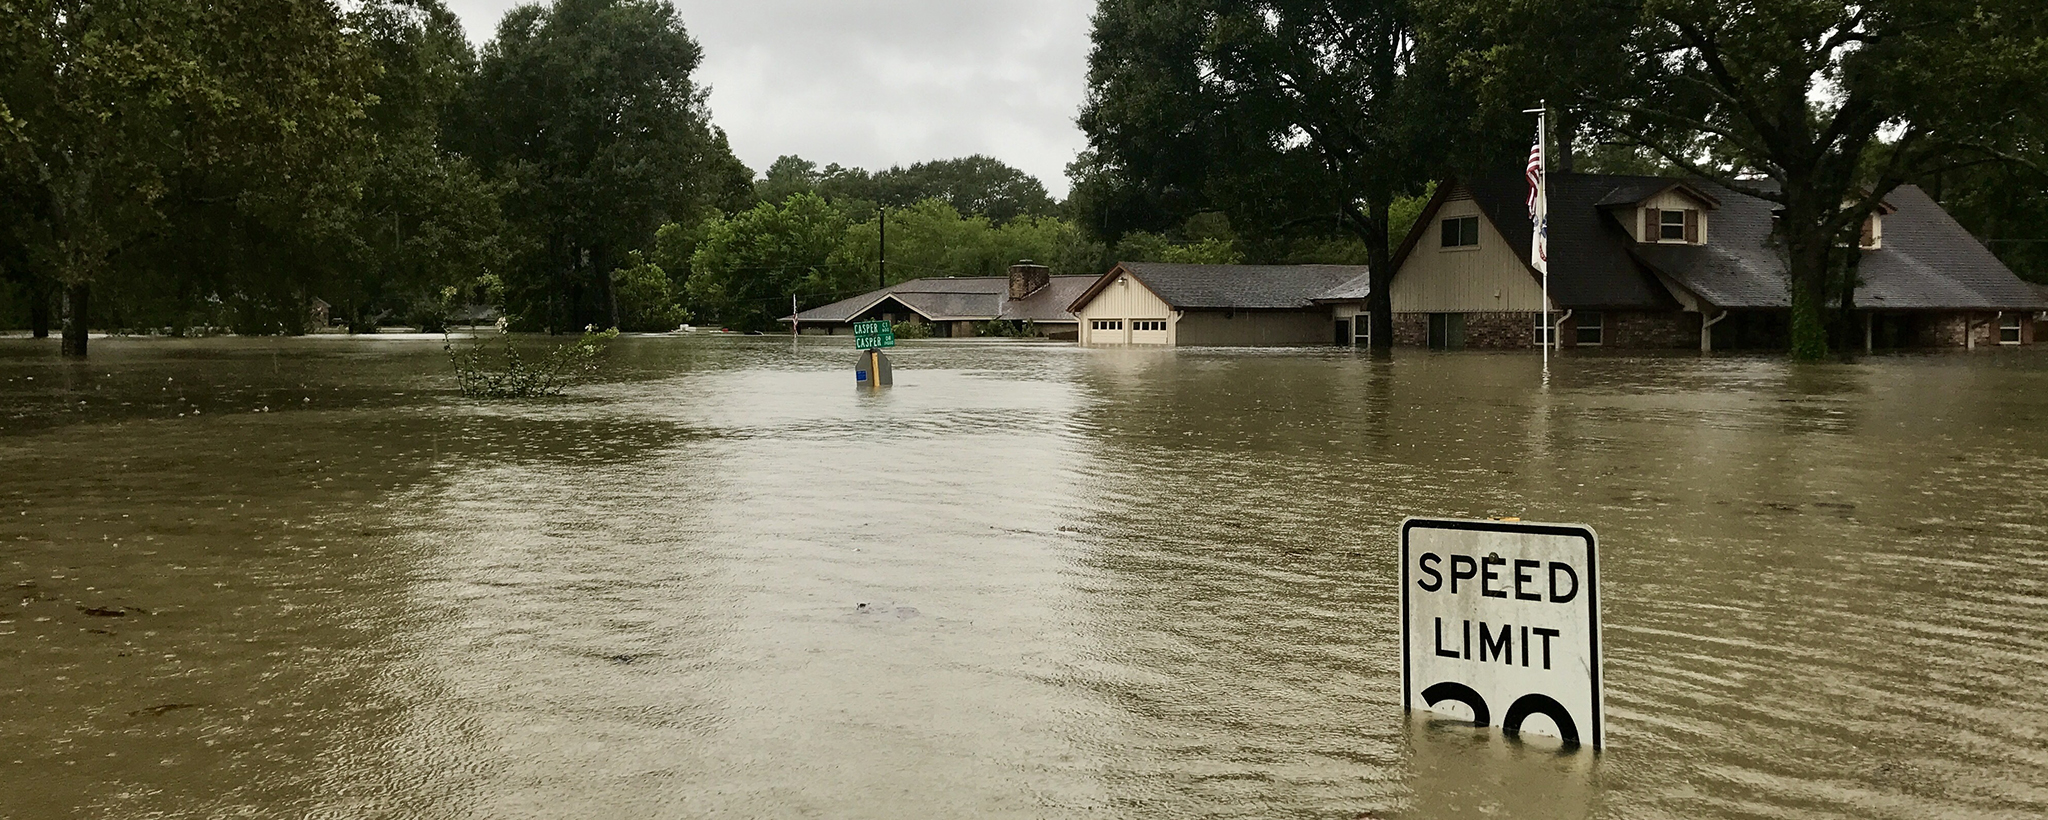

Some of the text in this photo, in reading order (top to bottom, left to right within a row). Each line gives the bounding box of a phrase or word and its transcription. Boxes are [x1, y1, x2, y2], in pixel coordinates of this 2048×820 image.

[854, 323, 878, 334] CASPER
[856, 336, 881, 348] CASPER
[1417, 552, 1579, 604] SPEED
[1435, 617, 1560, 670] LIMIT
